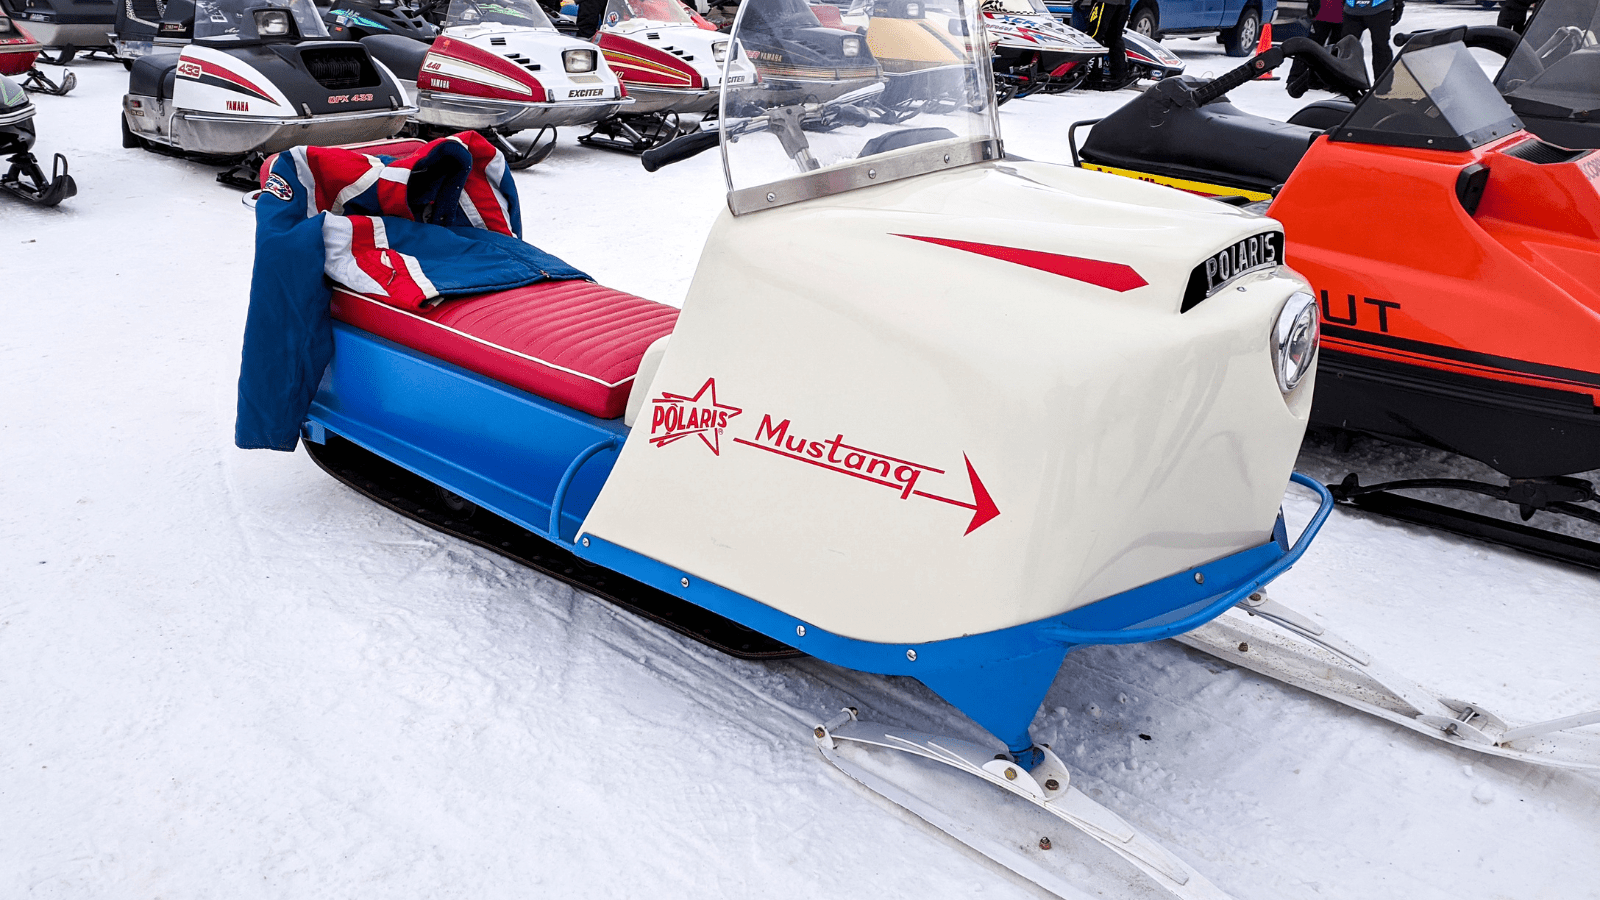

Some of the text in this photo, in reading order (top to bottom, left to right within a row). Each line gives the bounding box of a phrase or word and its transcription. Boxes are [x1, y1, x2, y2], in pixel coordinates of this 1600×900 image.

[760, 52, 783, 62] YAMAHA
[178, 63, 201, 77] 433
[426, 62, 441, 70] 440
[430, 78, 450, 89] YAMAHA
[351, 93, 374, 102] 433
[568, 88, 604, 98] EXCITER
[226, 100, 249, 112] YAMAHA
[1206, 232, 1276, 292] POLARIS
[1320, 289, 1401, 333] UT
[651, 404, 728, 434] POLARIS
